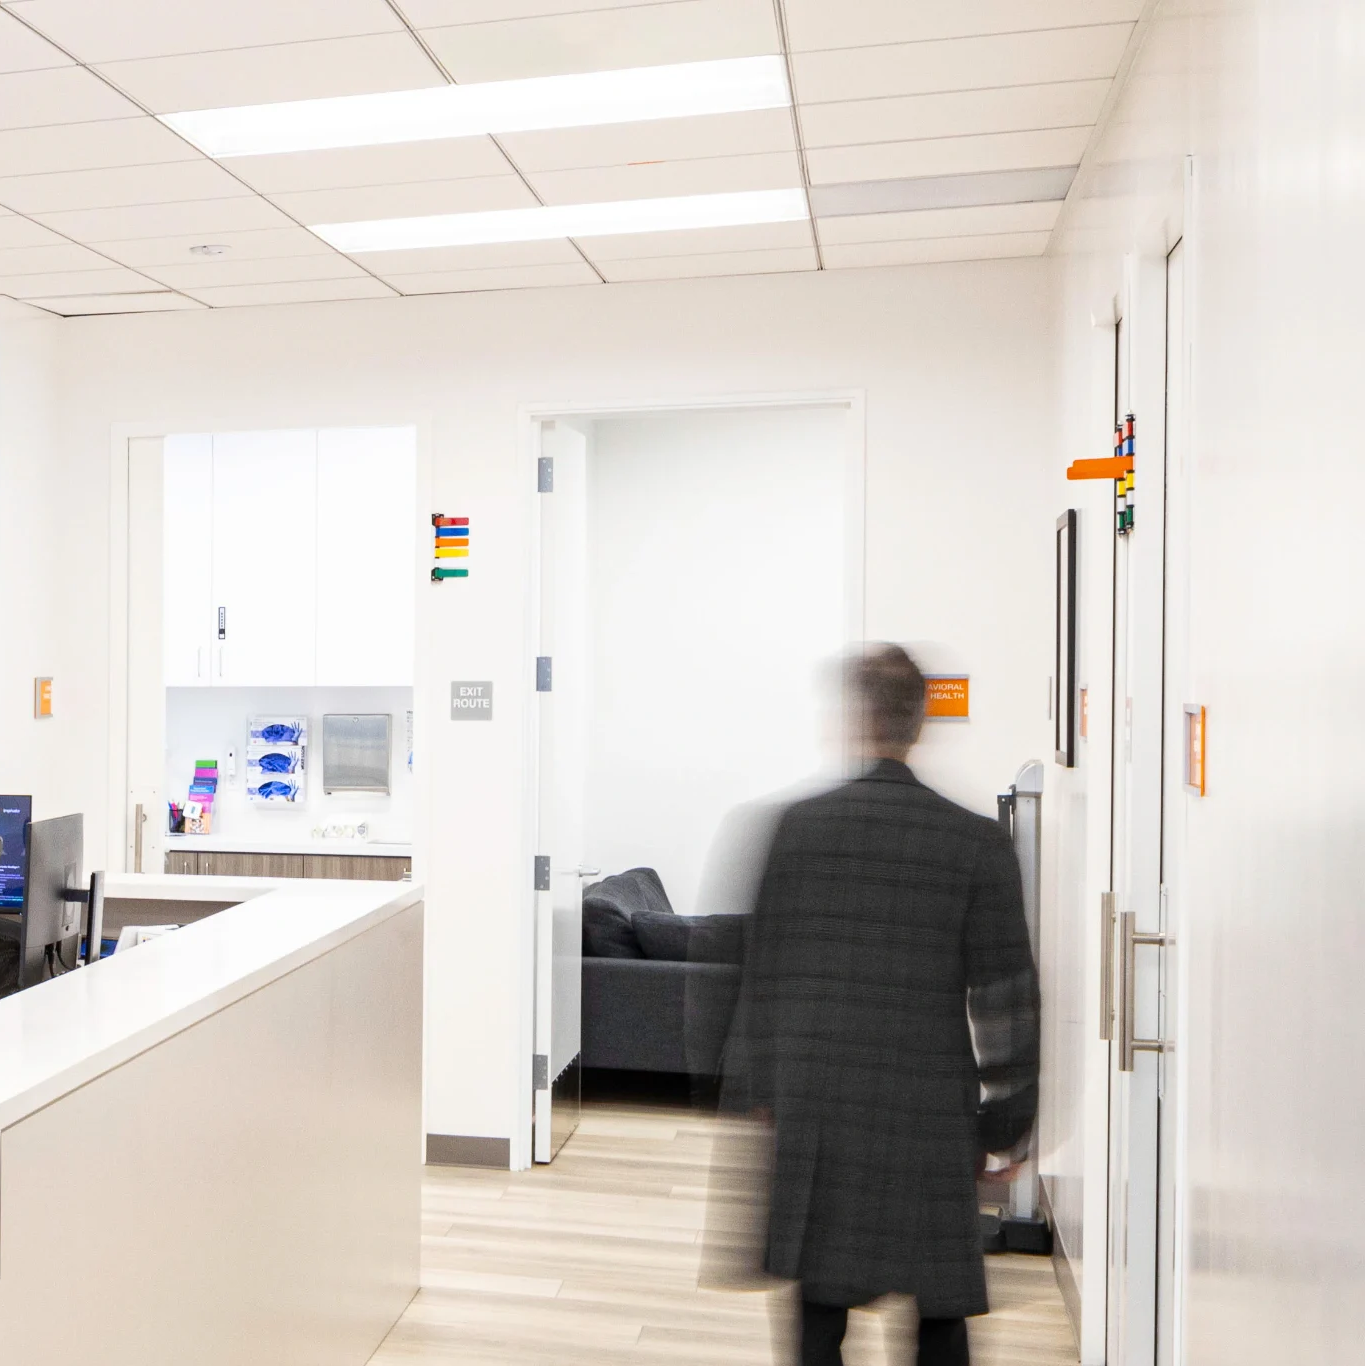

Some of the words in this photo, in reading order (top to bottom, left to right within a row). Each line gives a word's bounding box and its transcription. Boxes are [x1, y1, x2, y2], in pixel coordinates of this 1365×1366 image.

[459, 686, 483, 696] EXIT
[930, 692, 965, 700] HEALTH
[453, 698, 490, 709] ROUTE
